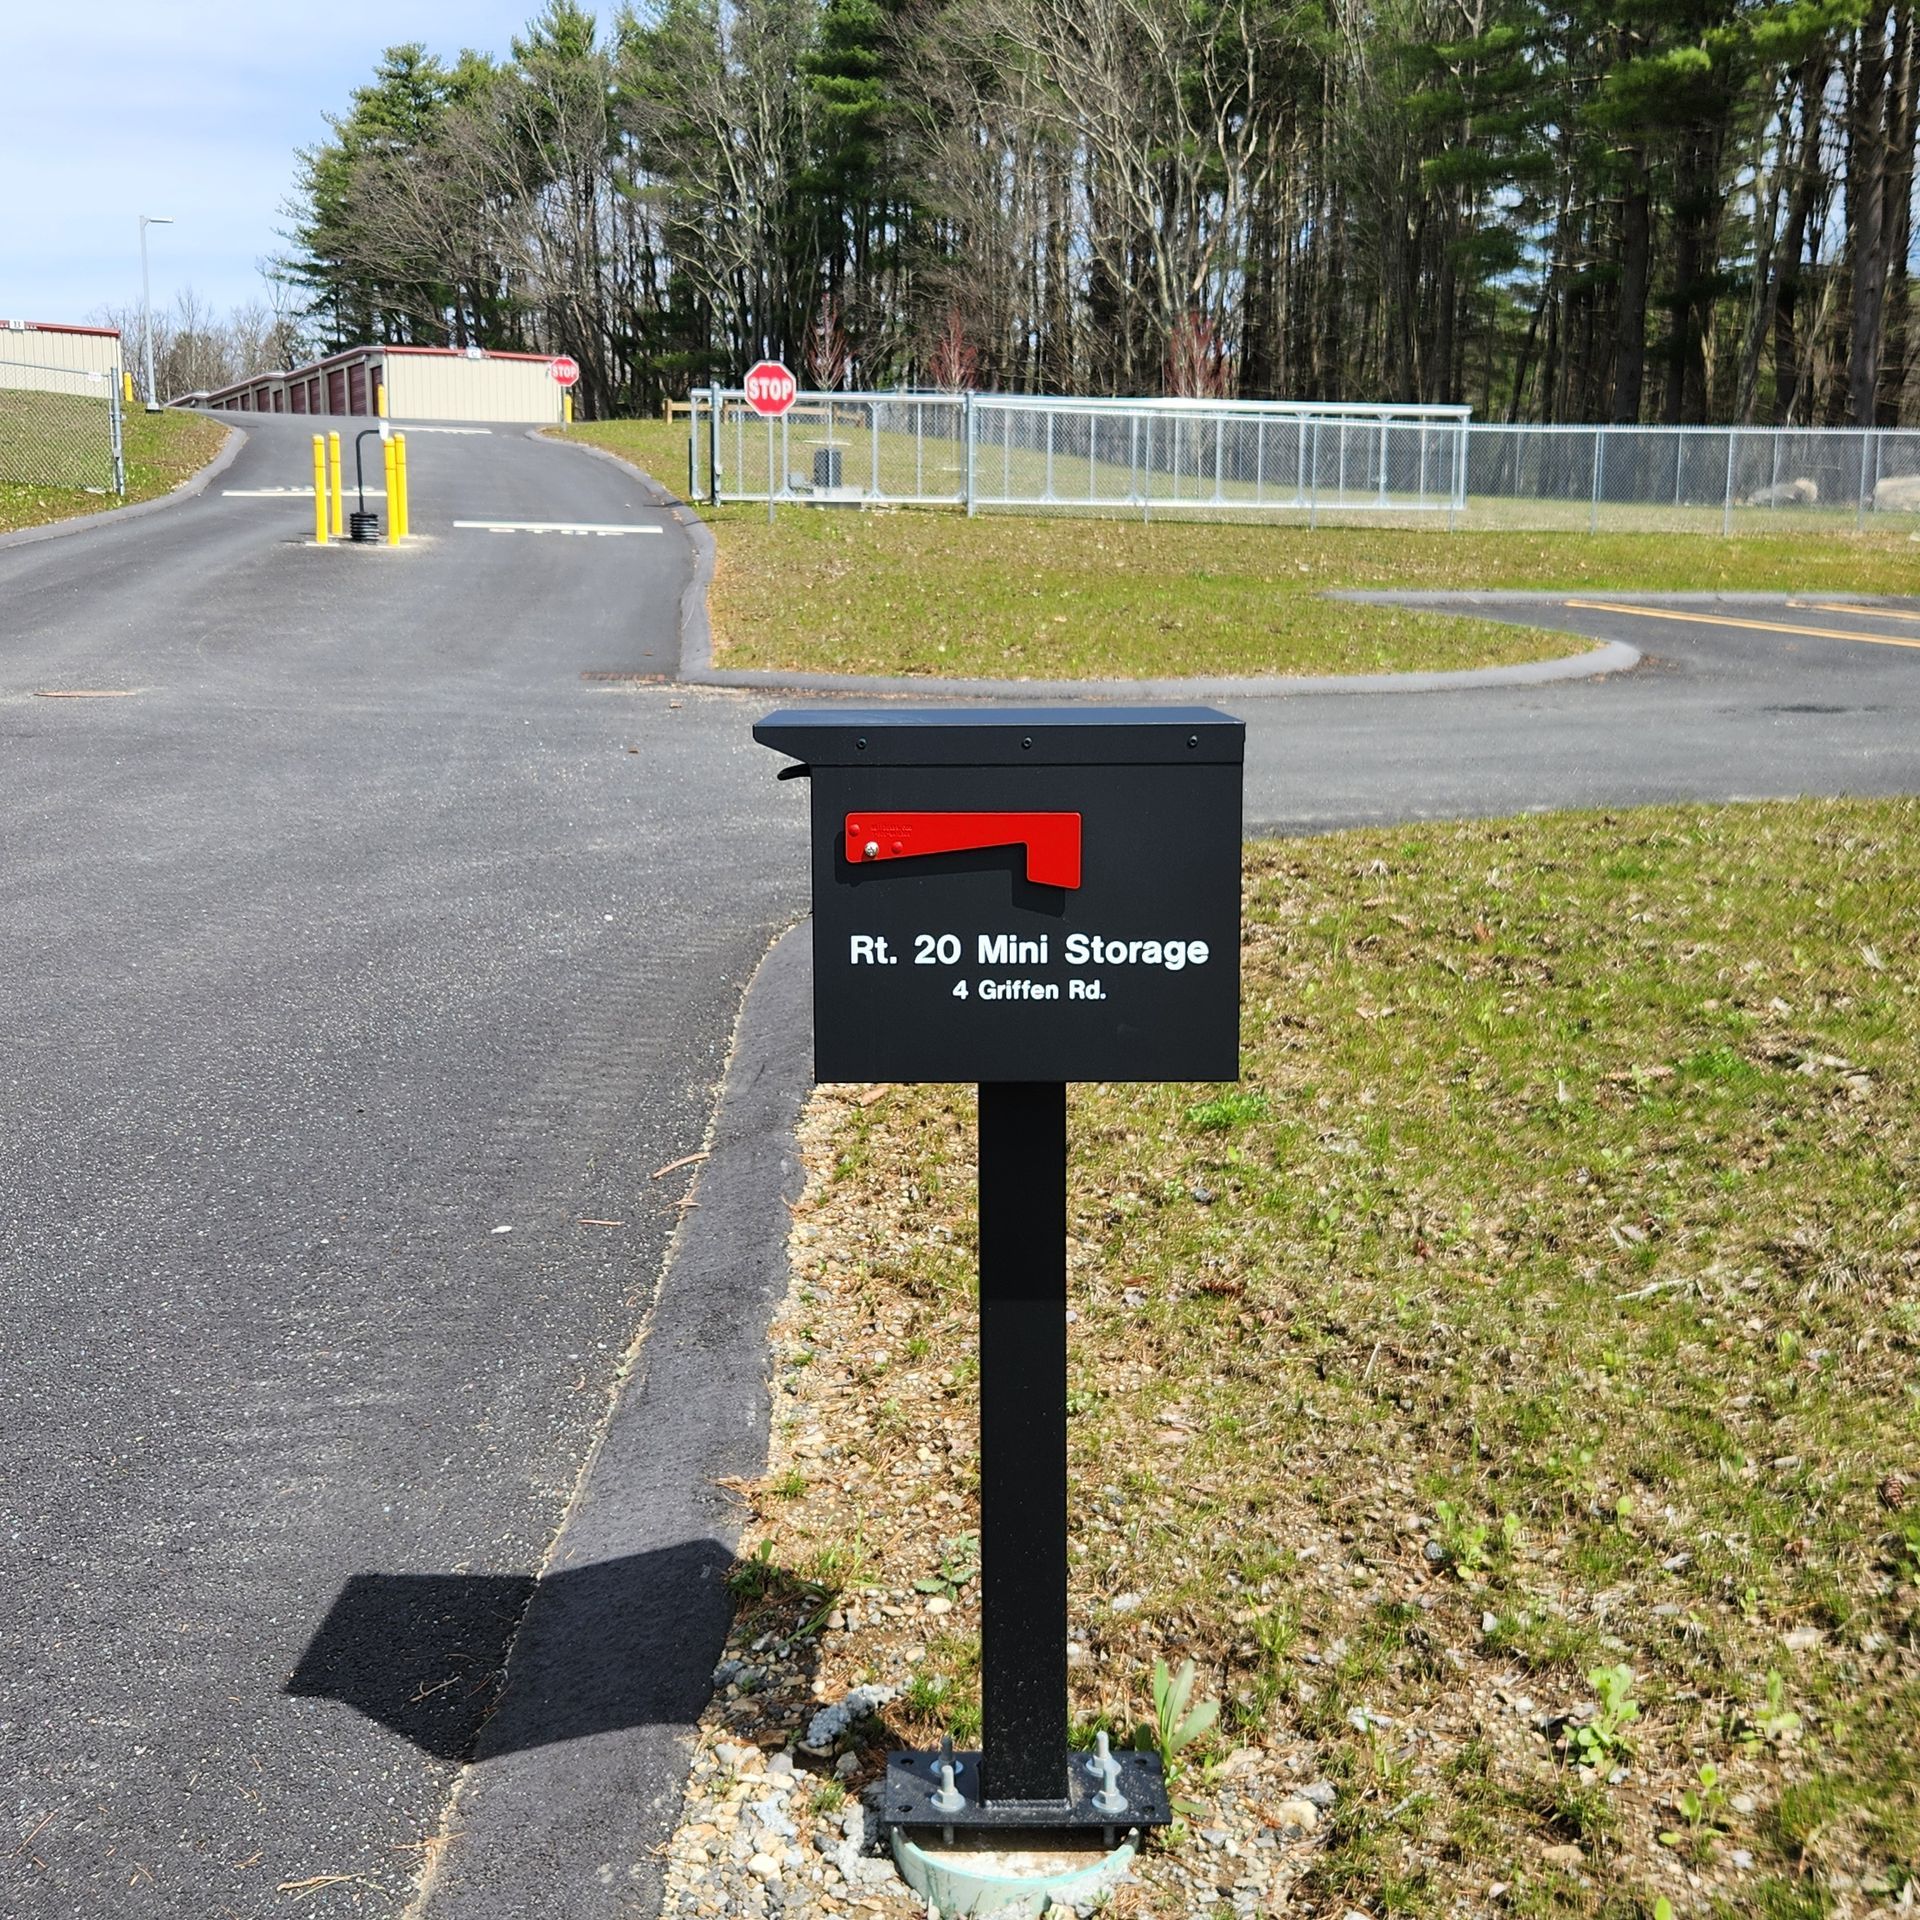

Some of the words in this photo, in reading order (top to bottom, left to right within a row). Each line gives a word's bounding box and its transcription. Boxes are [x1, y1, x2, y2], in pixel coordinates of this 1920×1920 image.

[552, 365, 577, 377] STOP
[748, 377, 792, 401] STOP
[850, 934, 898, 965] Rt.
[914, 933, 962, 965] 20
[978, 934, 1048, 964] Mini
[1064, 933, 1210, 971] Storage
[952, 979, 969, 1000] 4
[978, 979, 1060, 1001] Griffen
[1068, 979, 1107, 1000] Rd.
